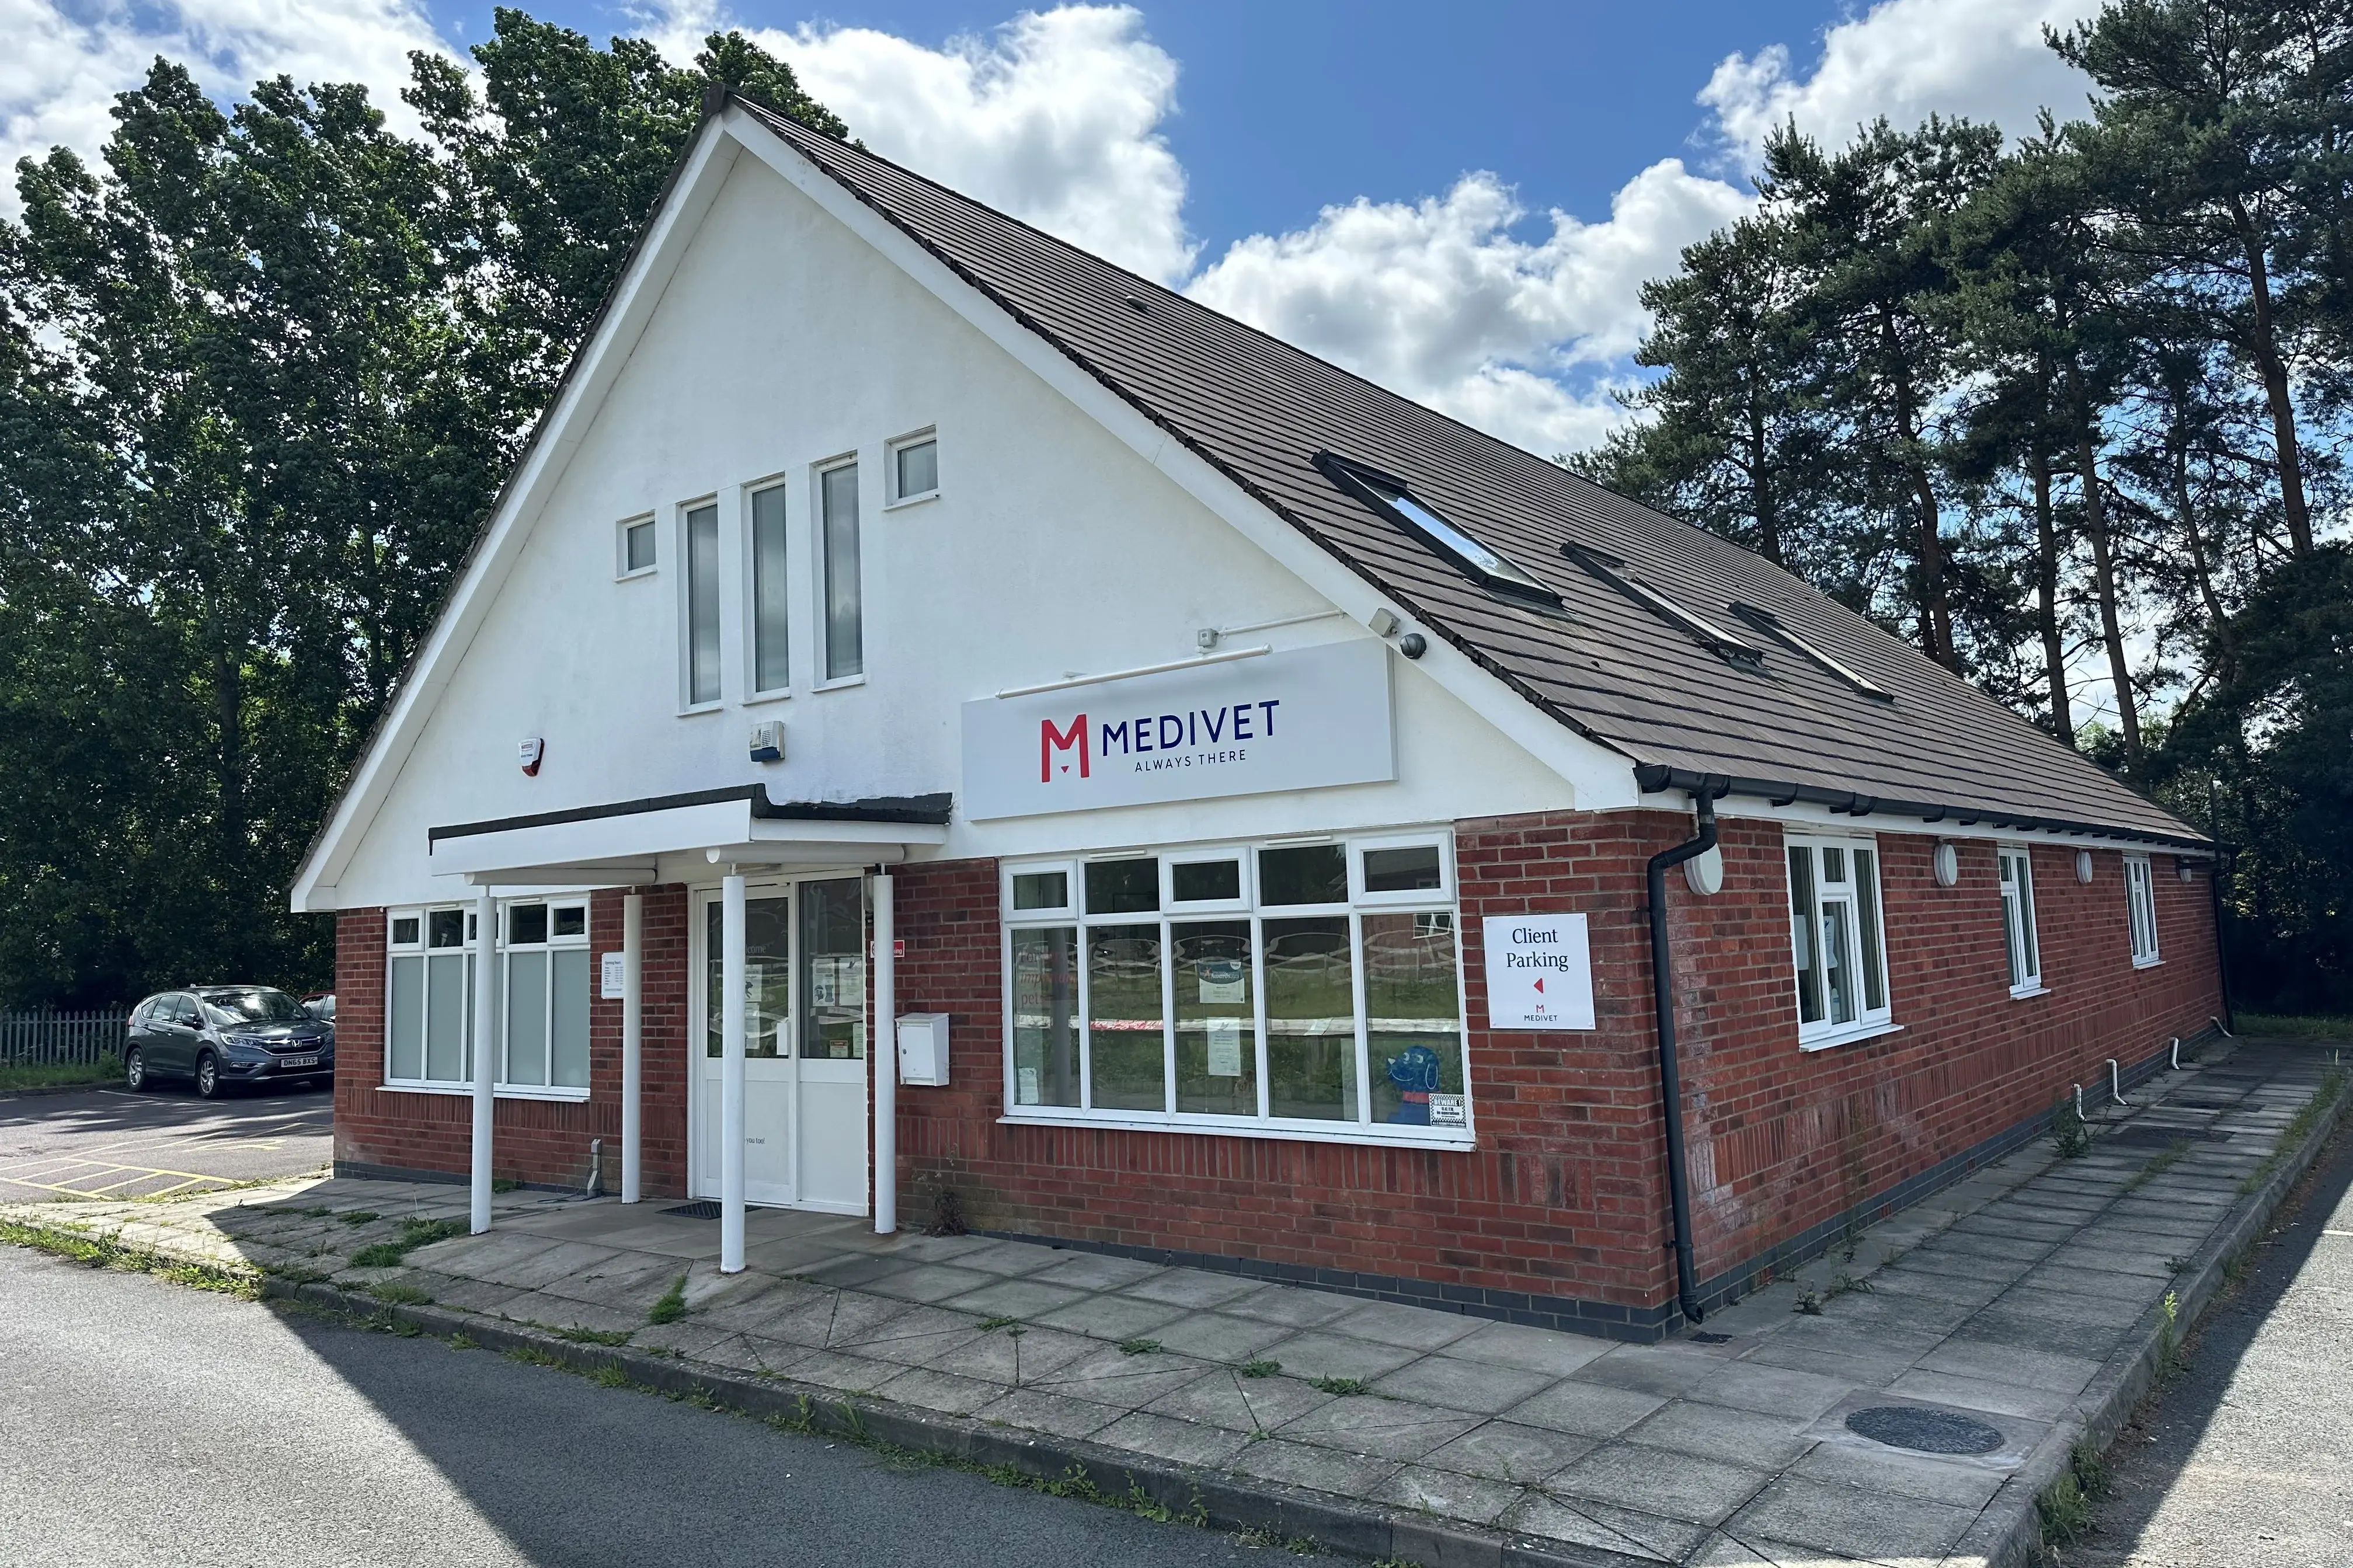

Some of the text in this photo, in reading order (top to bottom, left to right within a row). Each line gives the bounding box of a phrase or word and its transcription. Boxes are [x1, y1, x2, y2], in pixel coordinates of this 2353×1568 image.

[1102, 699, 1279, 757] MEDIVET
[1134, 749, 1247, 772] ALWAYS THERE
[1512, 927, 1559, 944] Client
[746, 944, 767, 954] lcome
[1506, 951, 1569, 972] Parking
